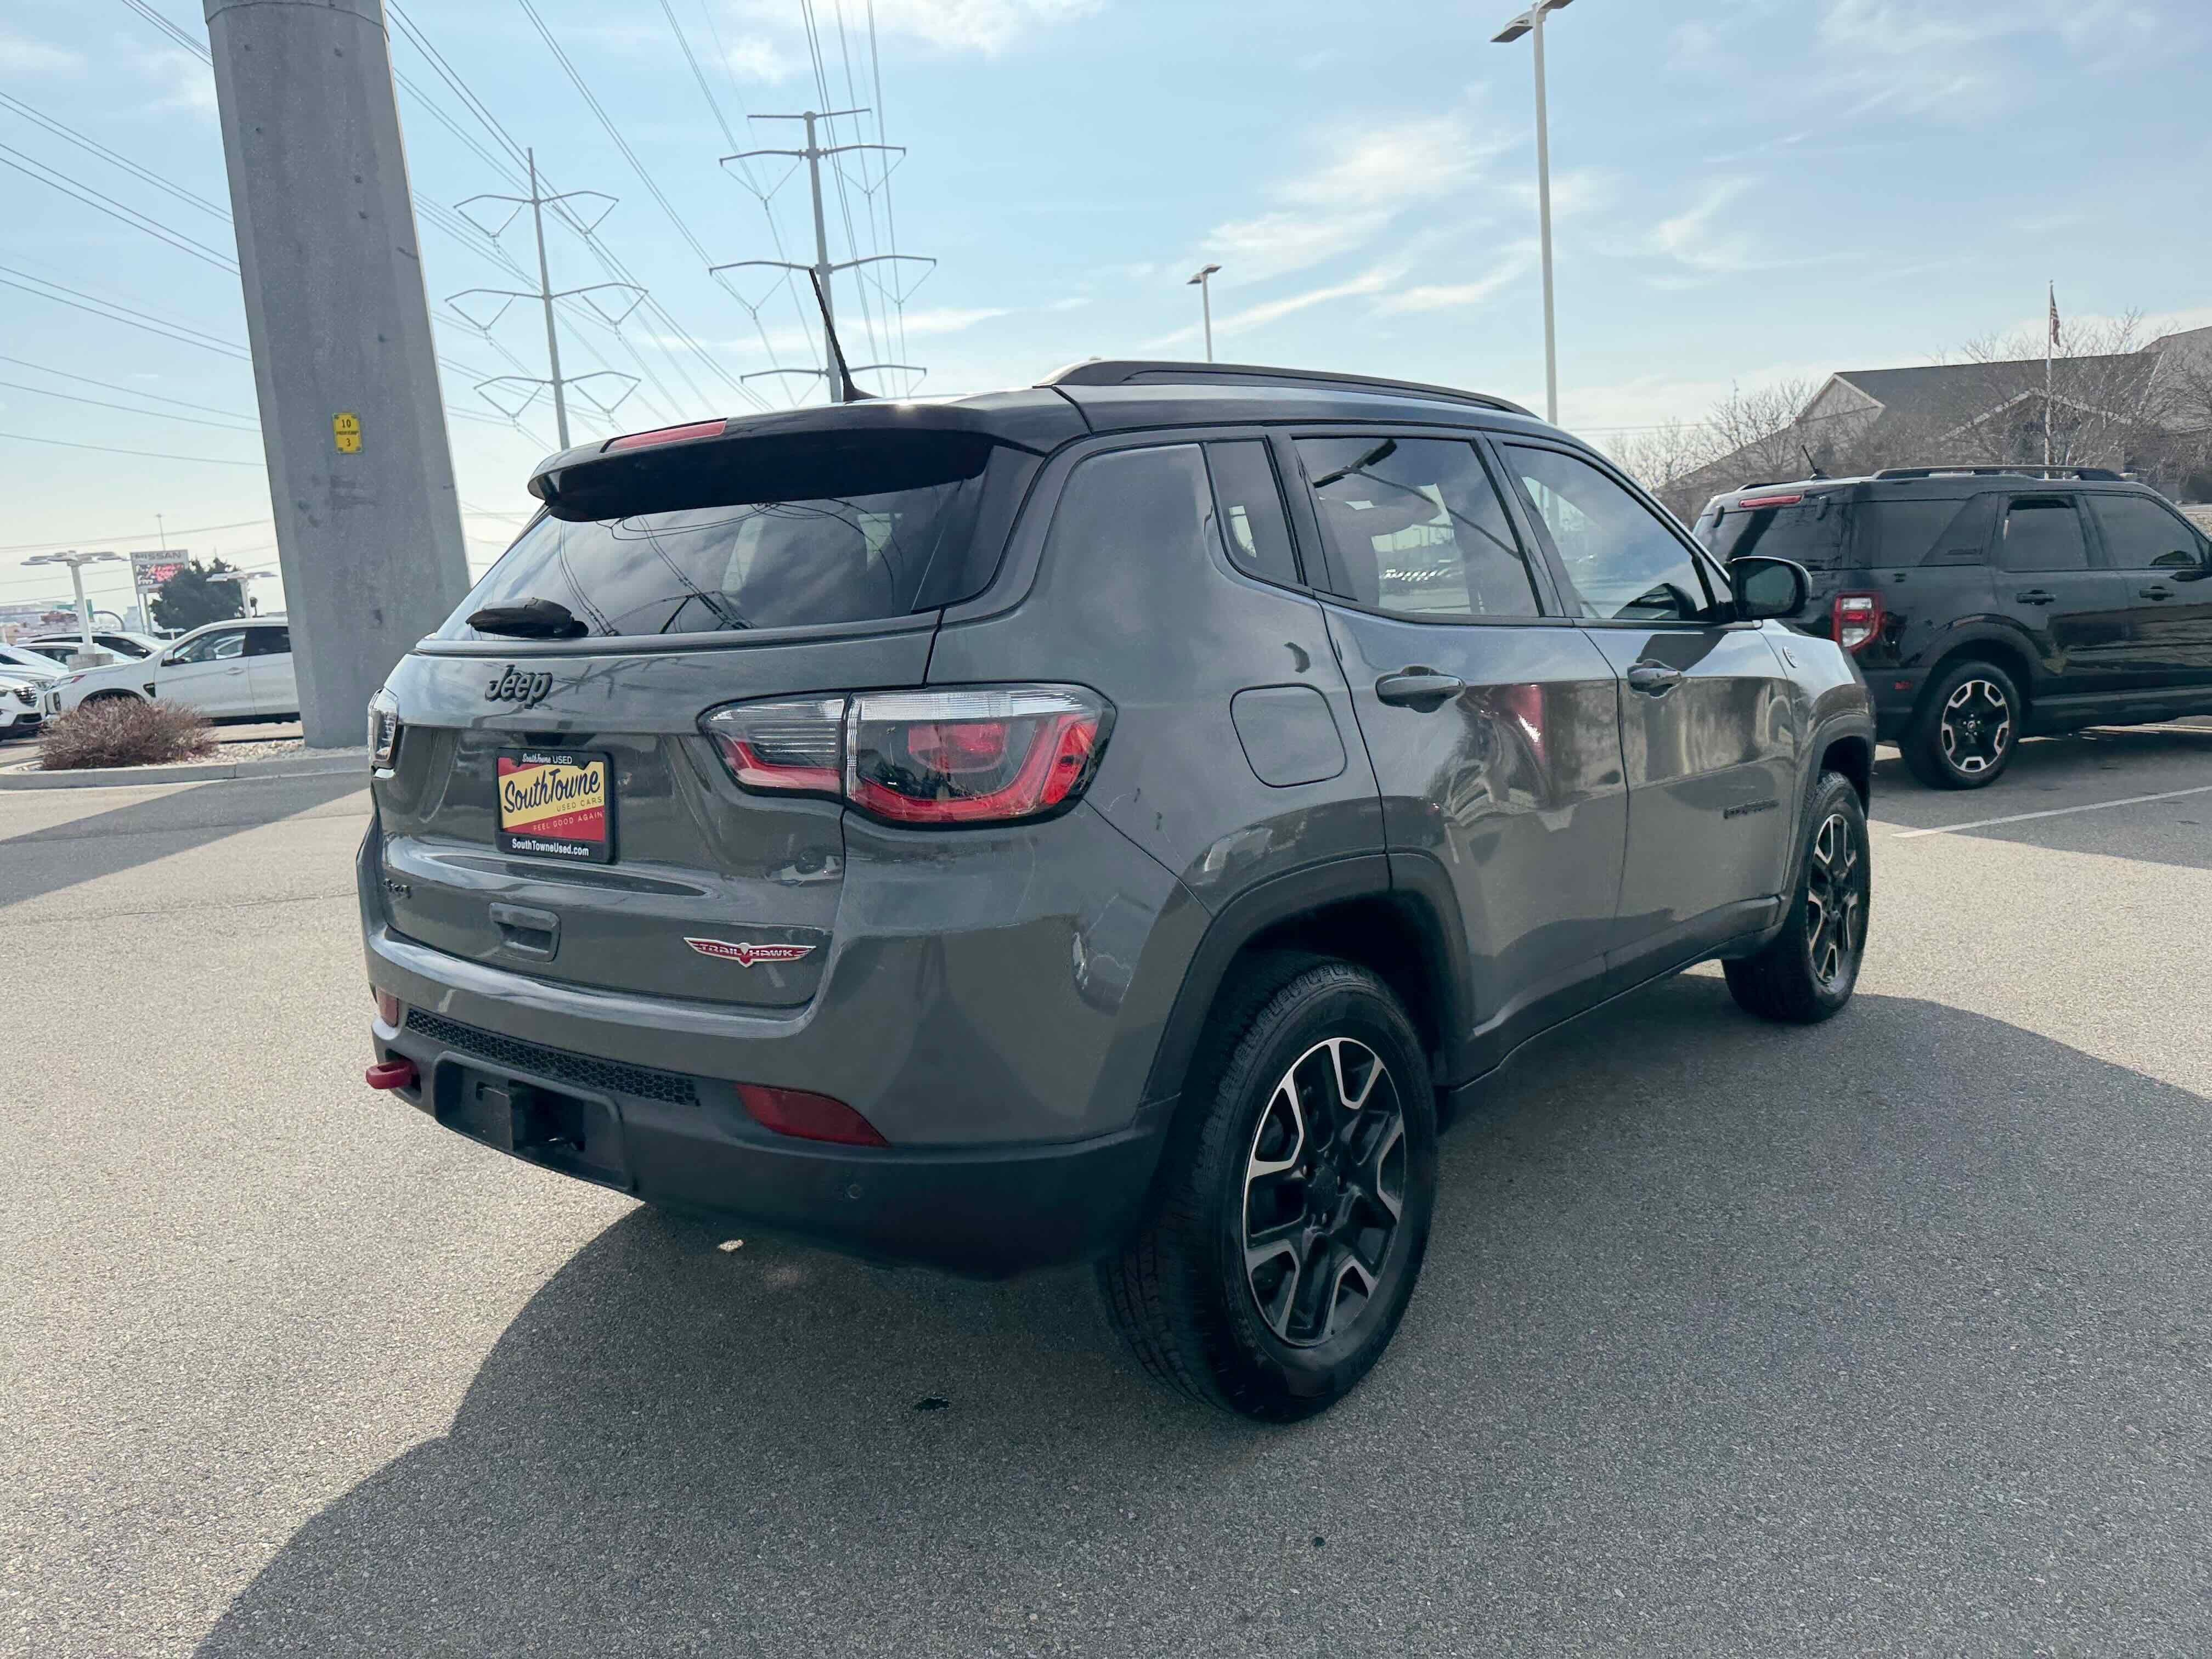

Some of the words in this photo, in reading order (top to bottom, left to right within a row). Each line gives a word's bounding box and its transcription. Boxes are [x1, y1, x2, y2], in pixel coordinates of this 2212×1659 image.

[342, 419, 351, 428] 10
[346, 438, 351, 447] 3
[485, 664, 553, 709] Jeep
[552, 755, 573, 764] USED
[504, 768, 600, 813] SouthTowne
[557, 802, 576, 812] USED
[580, 796, 602, 806] CARS
[533, 823, 550, 831] FEEL
[553, 817, 574, 828] GOOD
[578, 811, 602, 822] AGAIN
[512, 838, 589, 856] SouthTowneUsed.com
